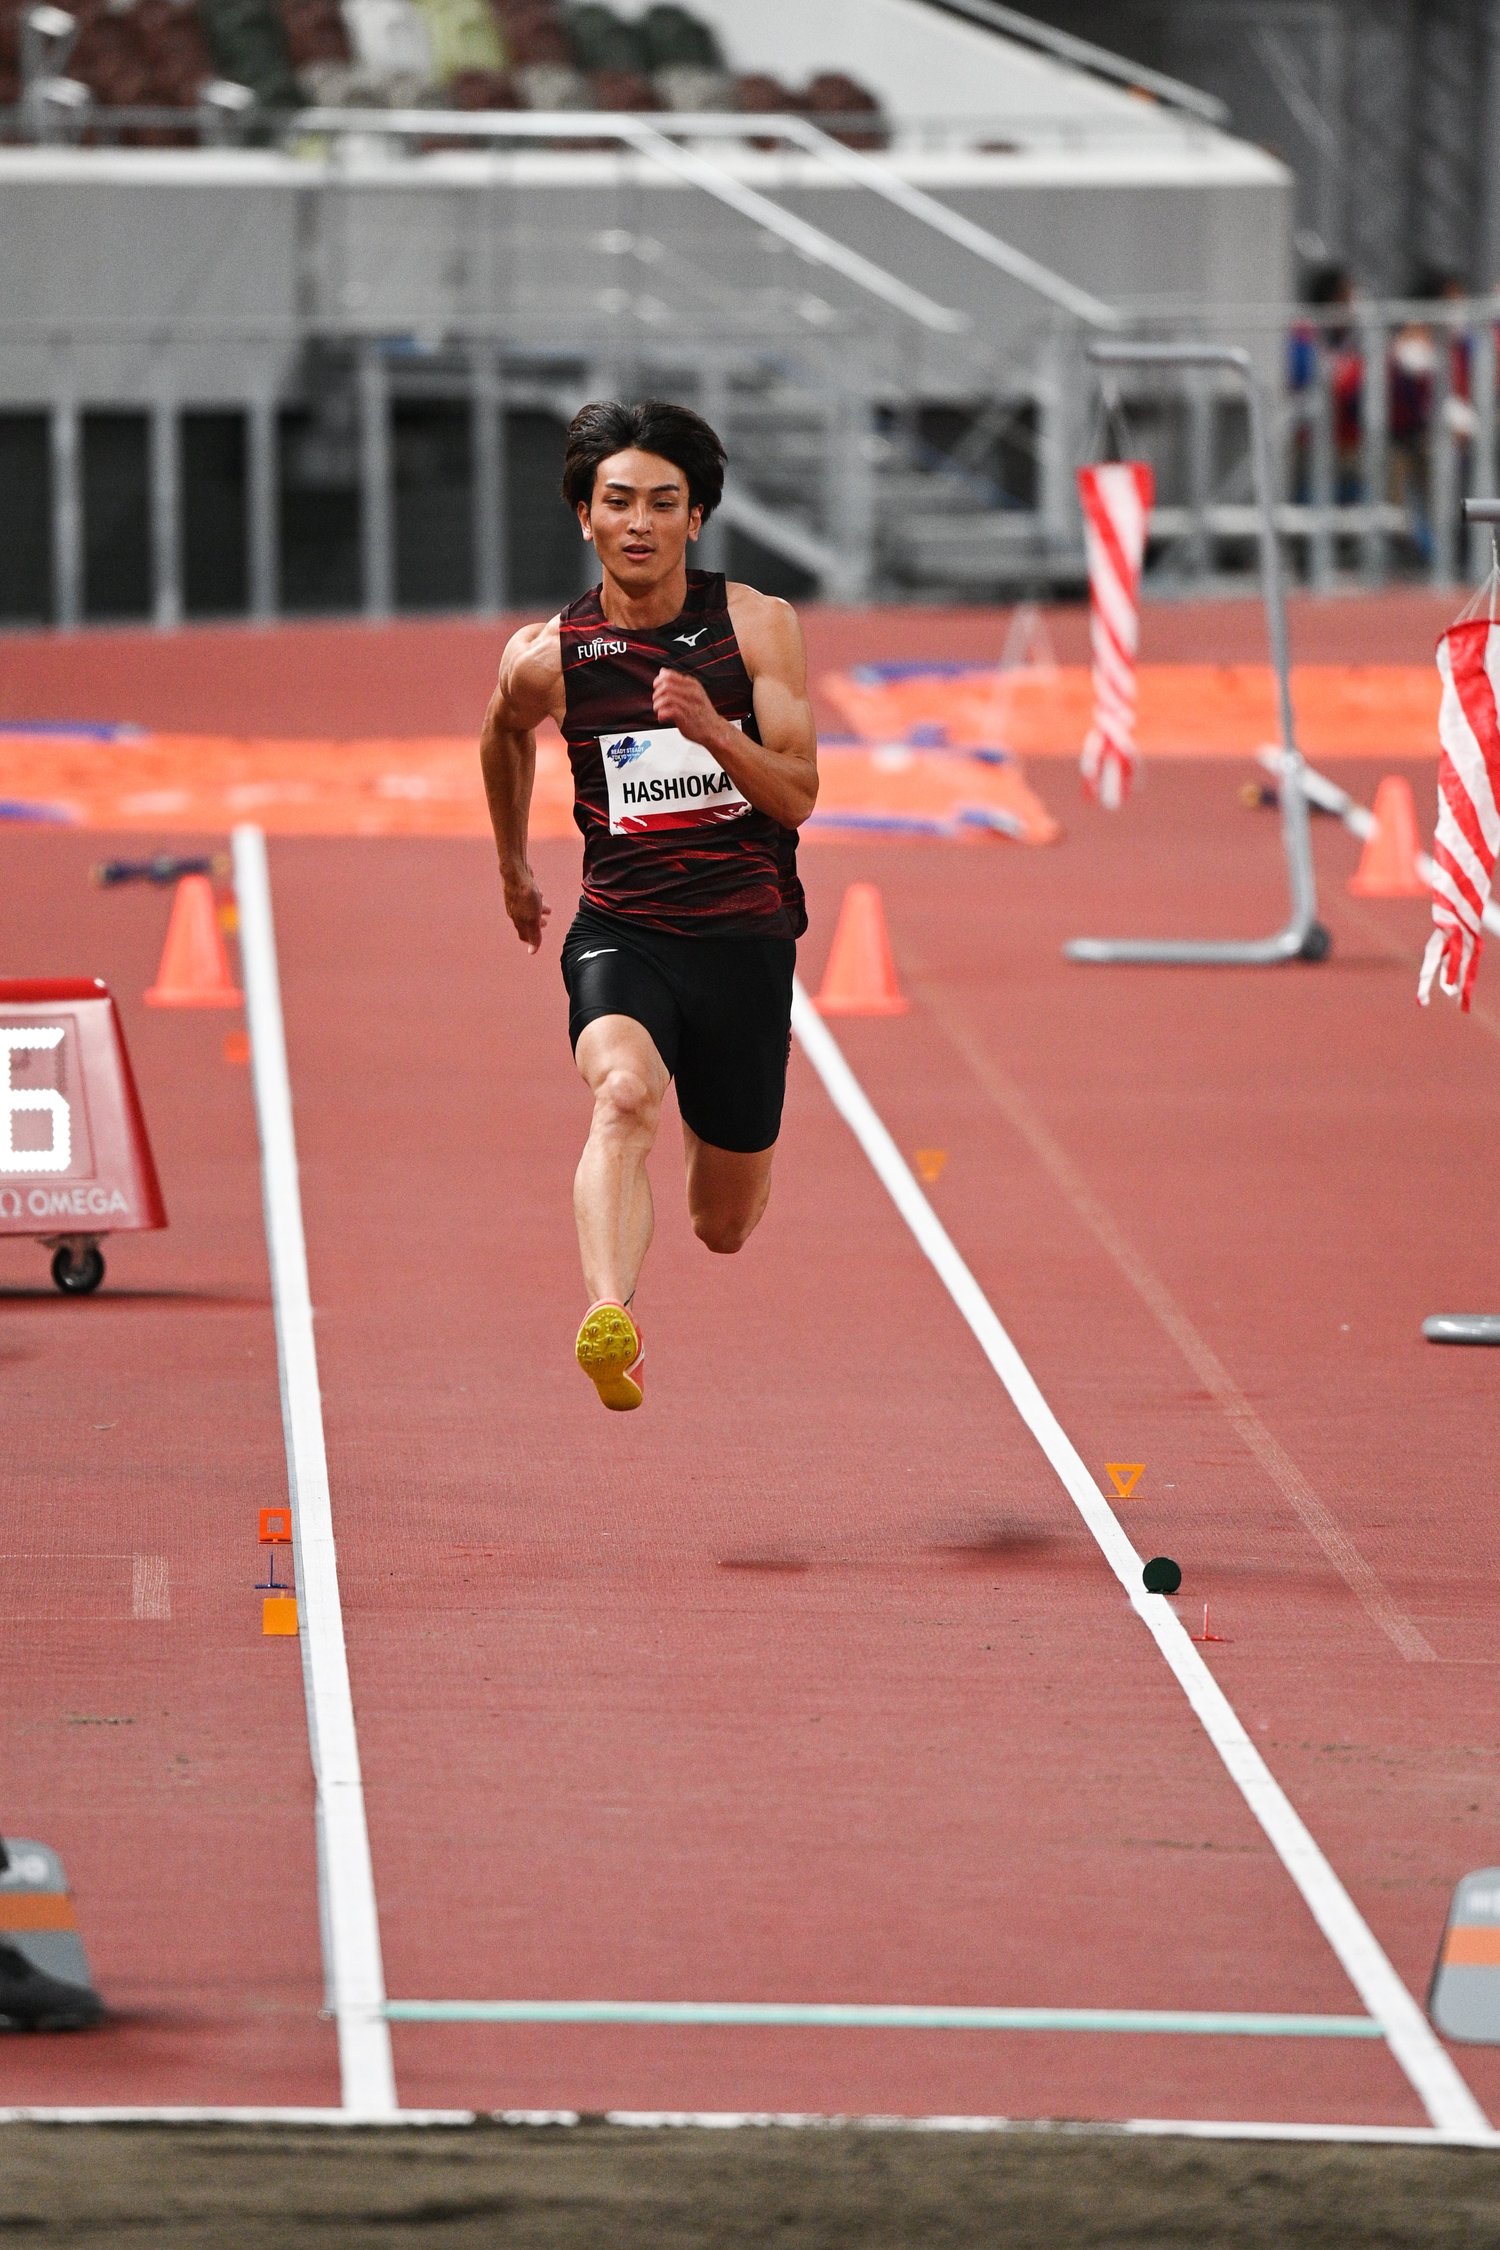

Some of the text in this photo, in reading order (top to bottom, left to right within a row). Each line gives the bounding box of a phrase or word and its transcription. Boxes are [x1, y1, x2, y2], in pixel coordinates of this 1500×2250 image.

[577, 637, 627, 660] FUJITSU
[622, 771, 733, 804] HASHIOKA
[28, 1187, 129, 1216] OMEGA
